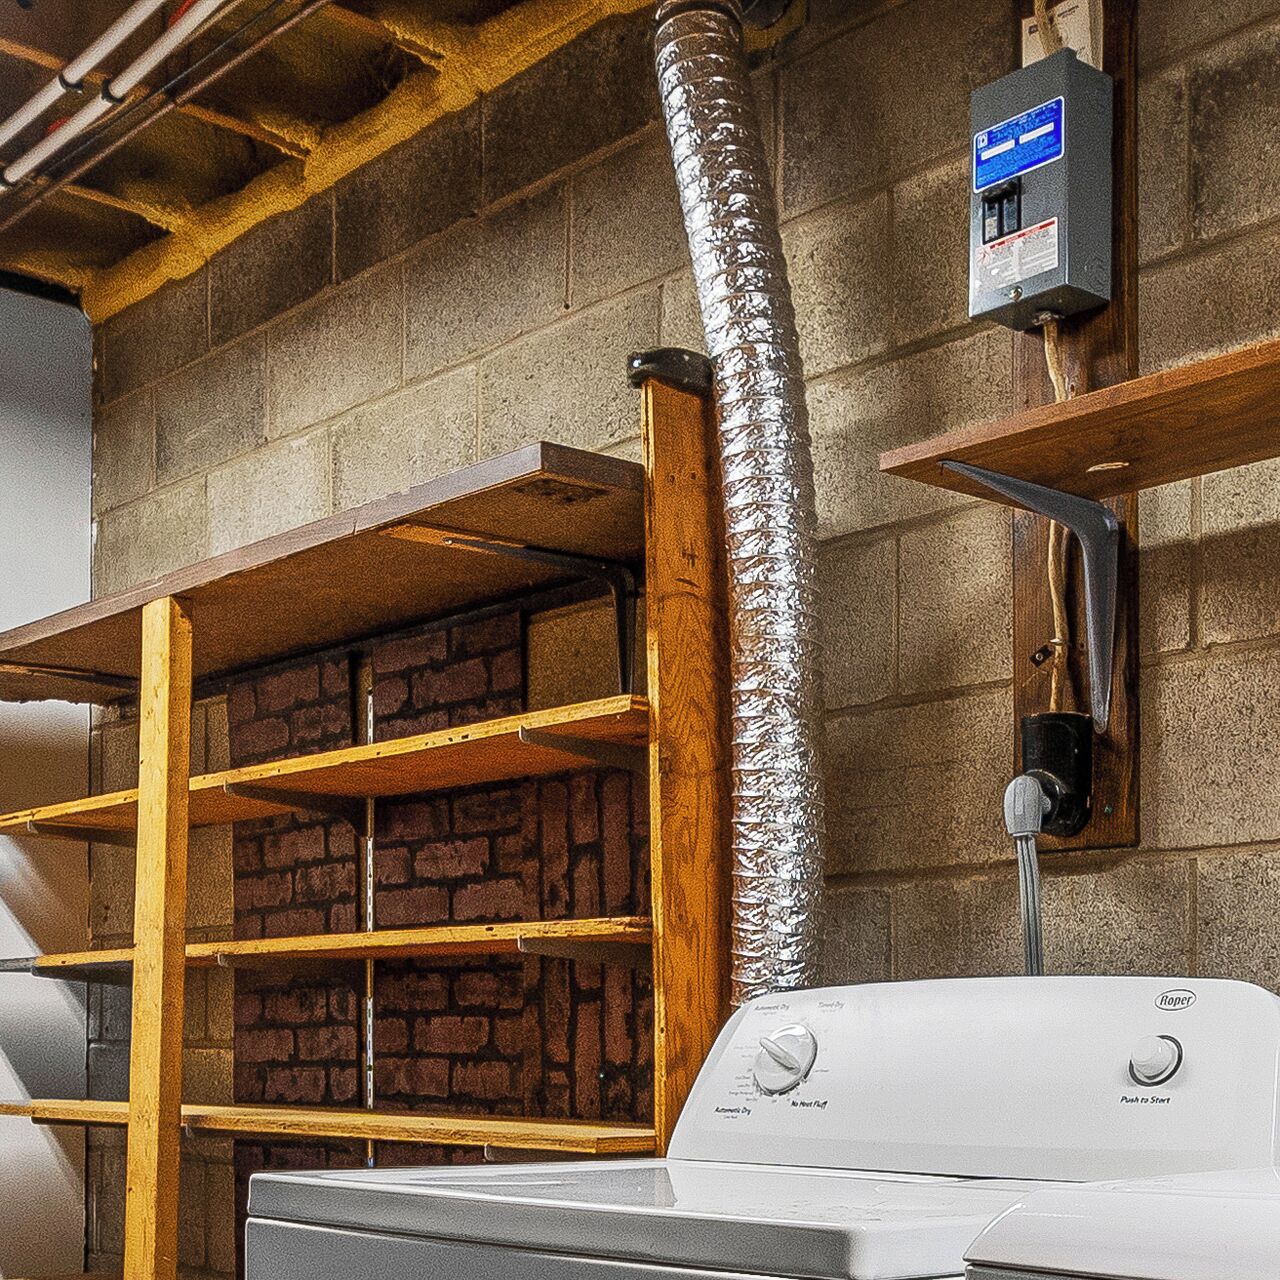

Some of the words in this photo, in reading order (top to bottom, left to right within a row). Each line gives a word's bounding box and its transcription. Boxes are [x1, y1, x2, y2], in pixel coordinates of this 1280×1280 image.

[1160, 994, 1193, 1007] Roper
[1120, 1095, 1139, 1103] Push
[1150, 1095, 1171, 1103] Start
[741, 1106, 751, 1115] Dry
